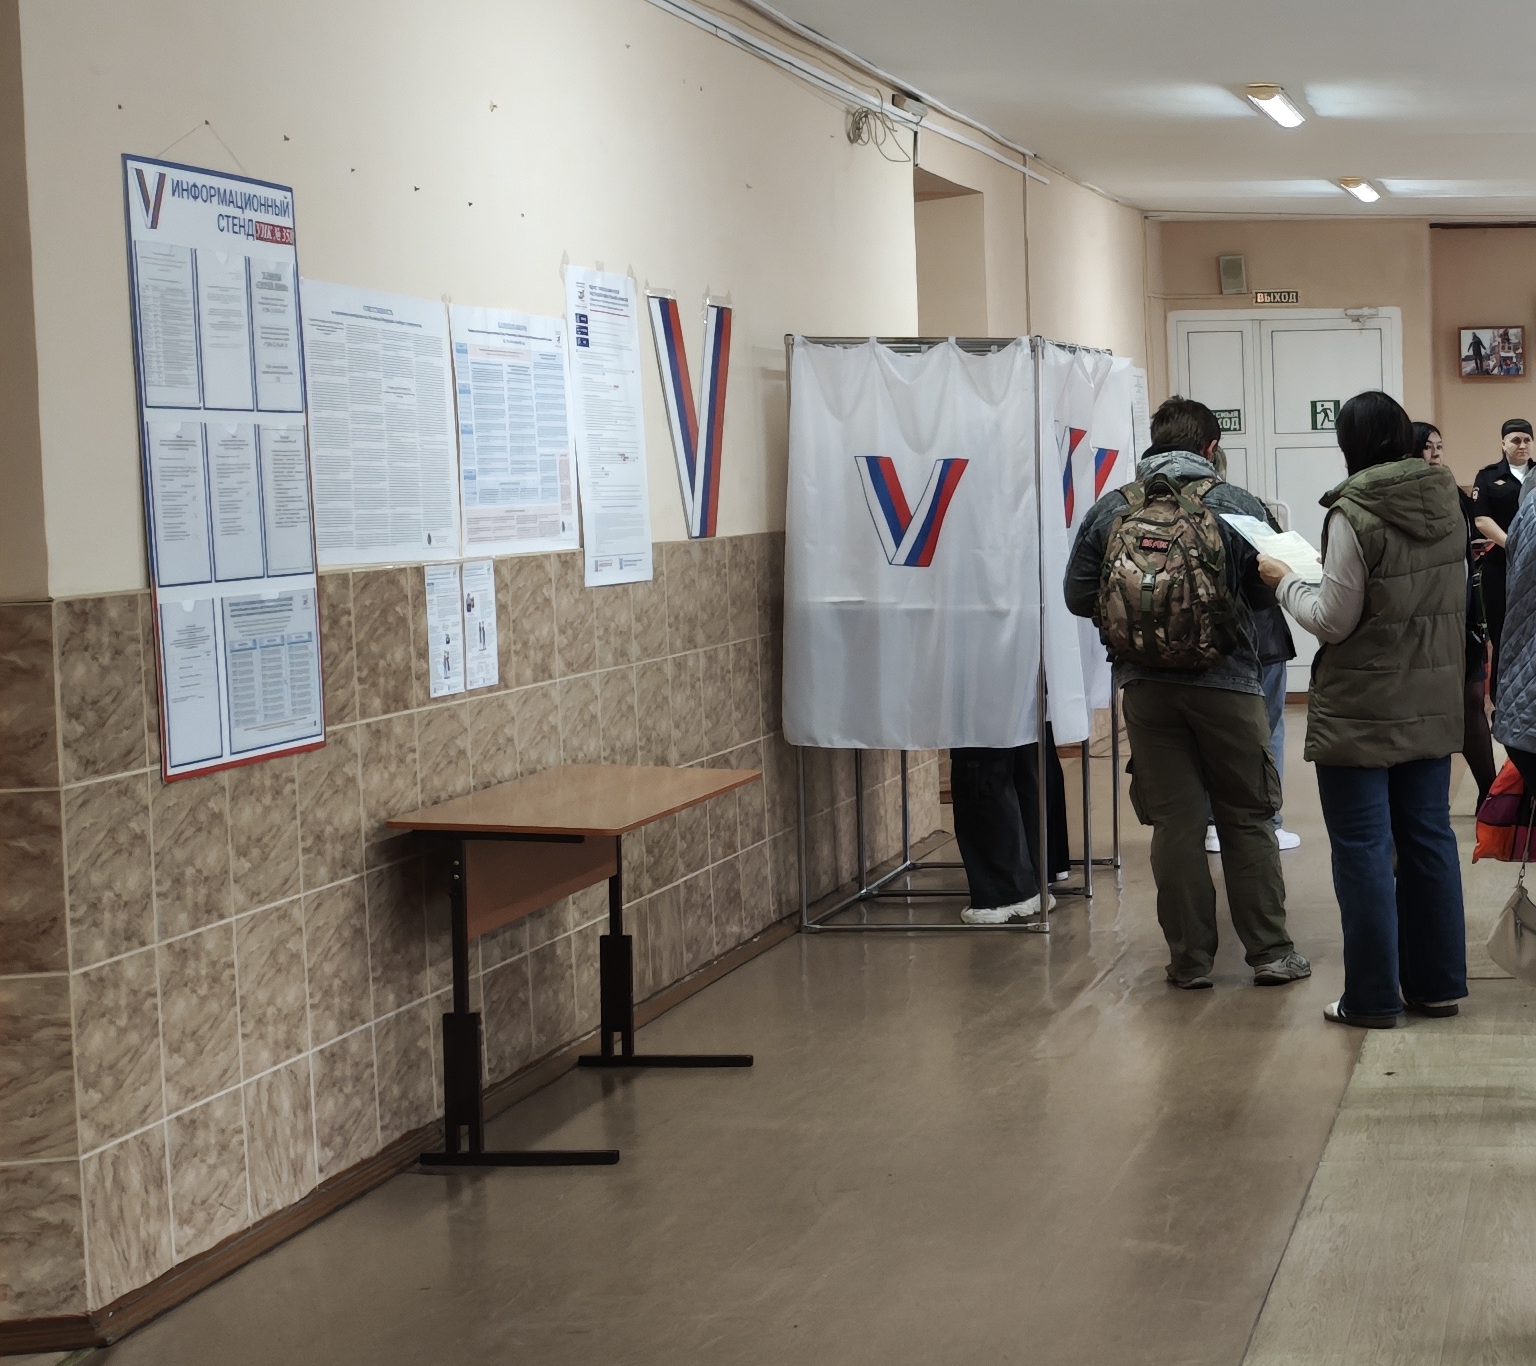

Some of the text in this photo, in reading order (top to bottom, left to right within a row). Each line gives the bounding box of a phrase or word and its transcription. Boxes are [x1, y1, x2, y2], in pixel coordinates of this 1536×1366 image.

[171, 178, 290, 218] ИНФОРМАЦИОННЫЙ
[217, 213, 255, 241] СТЕНД
[1257, 292, 1297, 303] ВЫХОД
